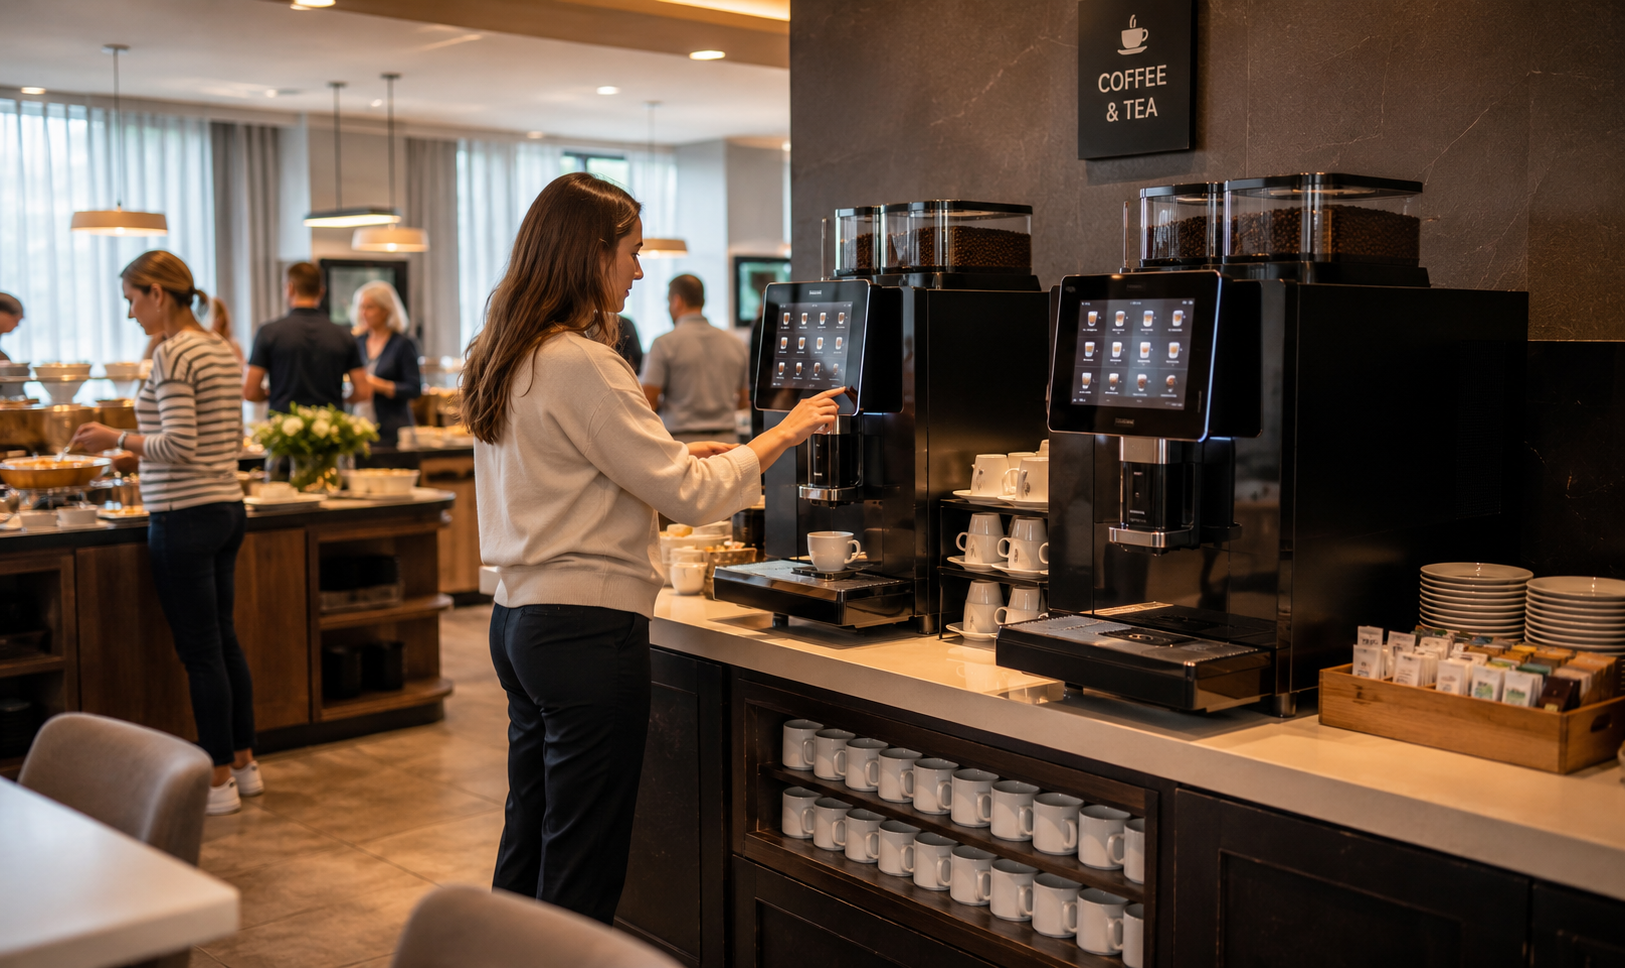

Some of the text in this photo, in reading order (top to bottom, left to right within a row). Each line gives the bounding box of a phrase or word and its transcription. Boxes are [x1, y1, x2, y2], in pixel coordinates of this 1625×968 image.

[1098, 64, 1167, 93] COFFEE
[1106, 97, 1158, 122] & TEA
